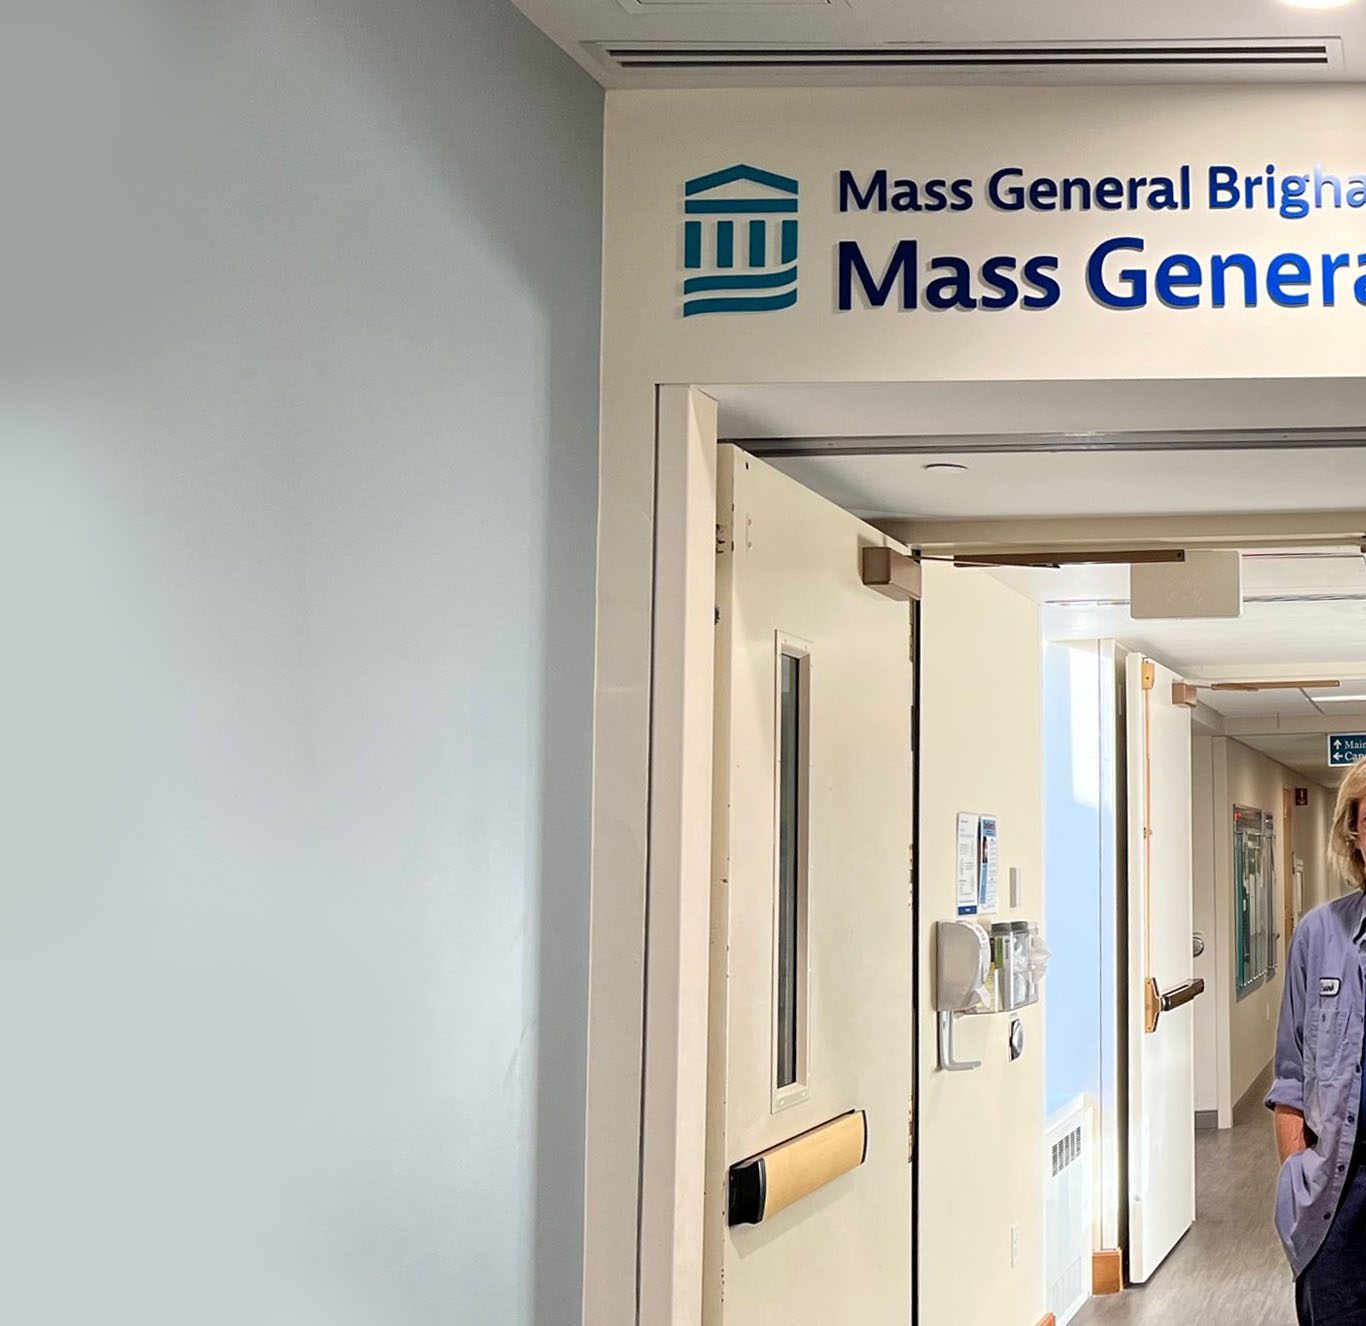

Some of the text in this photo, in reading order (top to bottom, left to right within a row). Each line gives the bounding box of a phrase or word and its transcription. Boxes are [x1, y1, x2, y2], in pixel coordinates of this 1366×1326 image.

[839, 169, 974, 213] Mass
[988, 165, 1191, 211] General
[838, 240, 1061, 311] Mass
